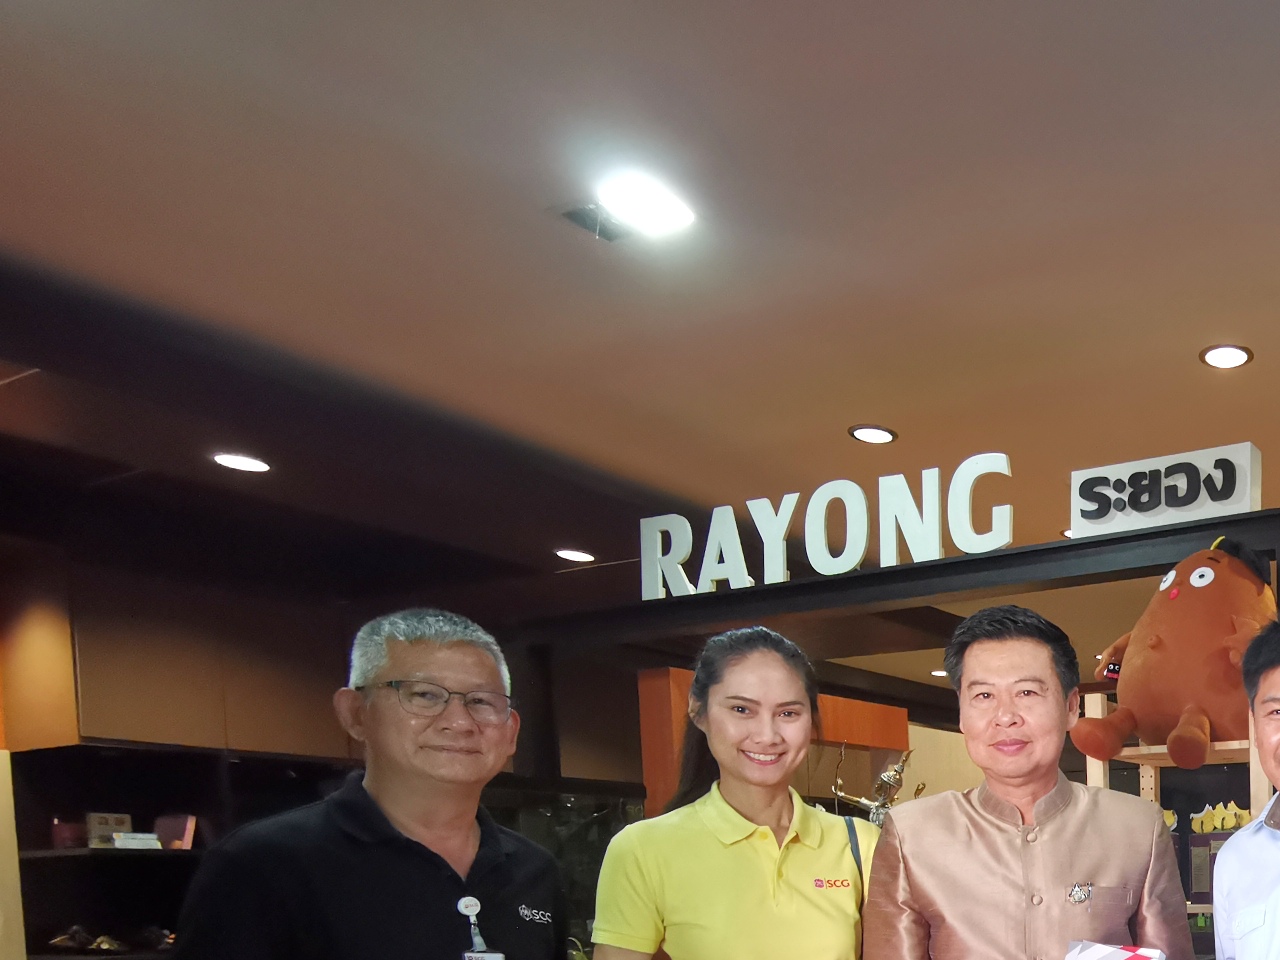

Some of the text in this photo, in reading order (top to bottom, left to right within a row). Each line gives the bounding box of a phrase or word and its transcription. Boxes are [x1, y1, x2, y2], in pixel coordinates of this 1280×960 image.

[1078, 457, 1237, 521] ระยอง
[640, 452, 1013, 600] RAYONG
[826, 879, 850, 888] SCG
